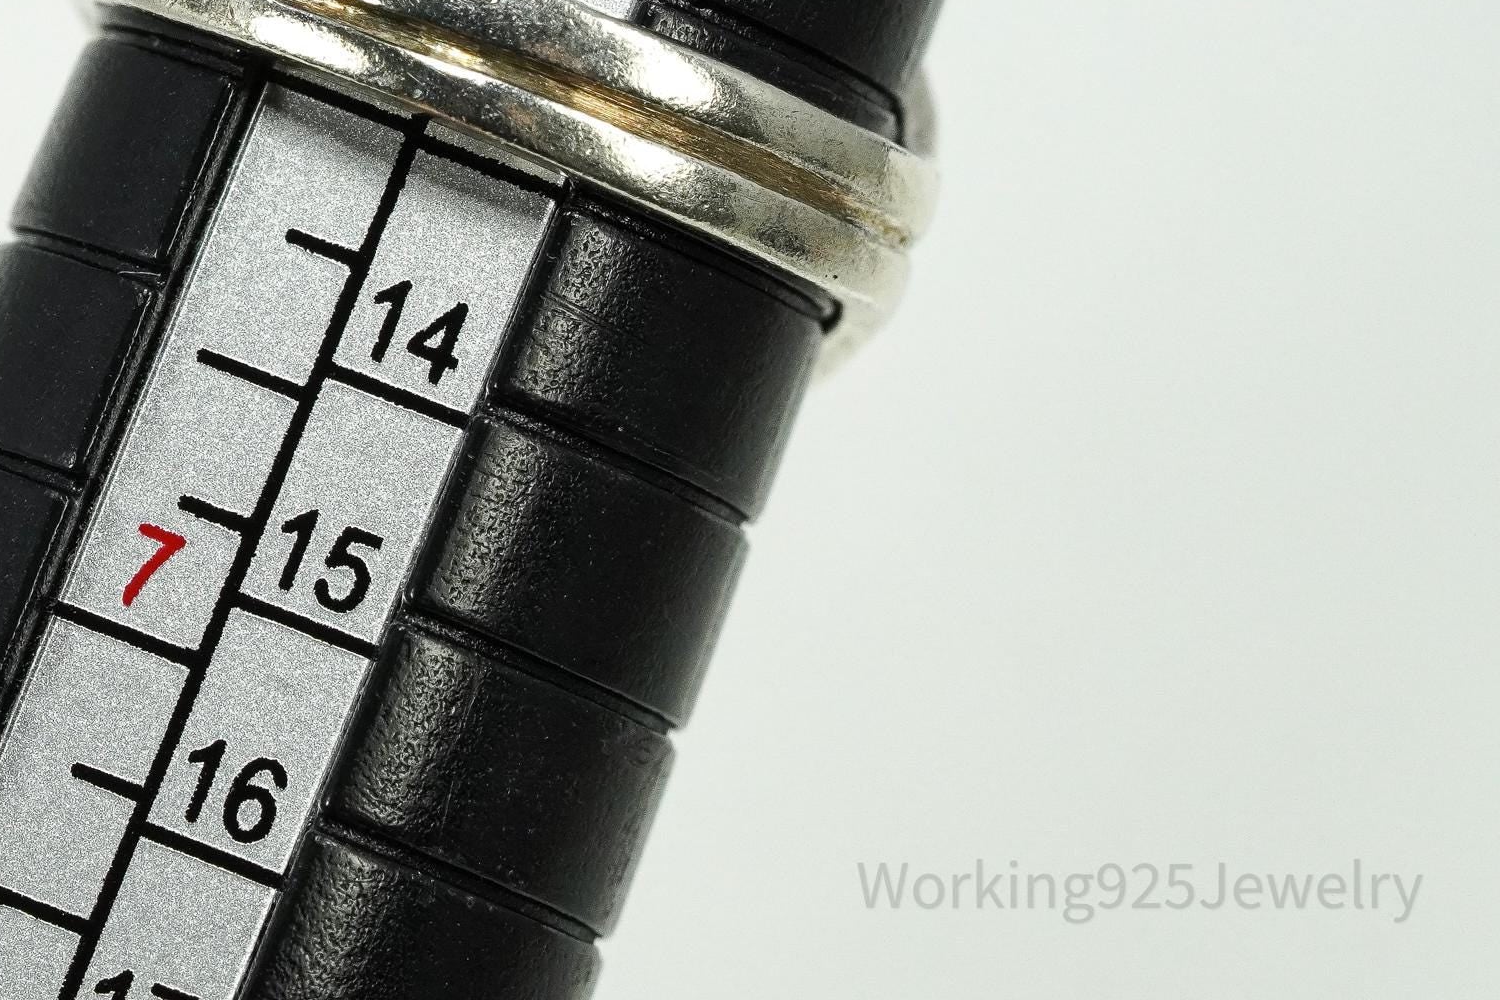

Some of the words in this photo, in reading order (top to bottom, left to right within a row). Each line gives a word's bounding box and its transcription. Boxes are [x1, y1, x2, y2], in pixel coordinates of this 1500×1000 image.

[370, 279, 470, 387] 14
[122, 522, 188, 609] 7
[278, 508, 385, 614] 15
[184, 738, 289, 845] 16
